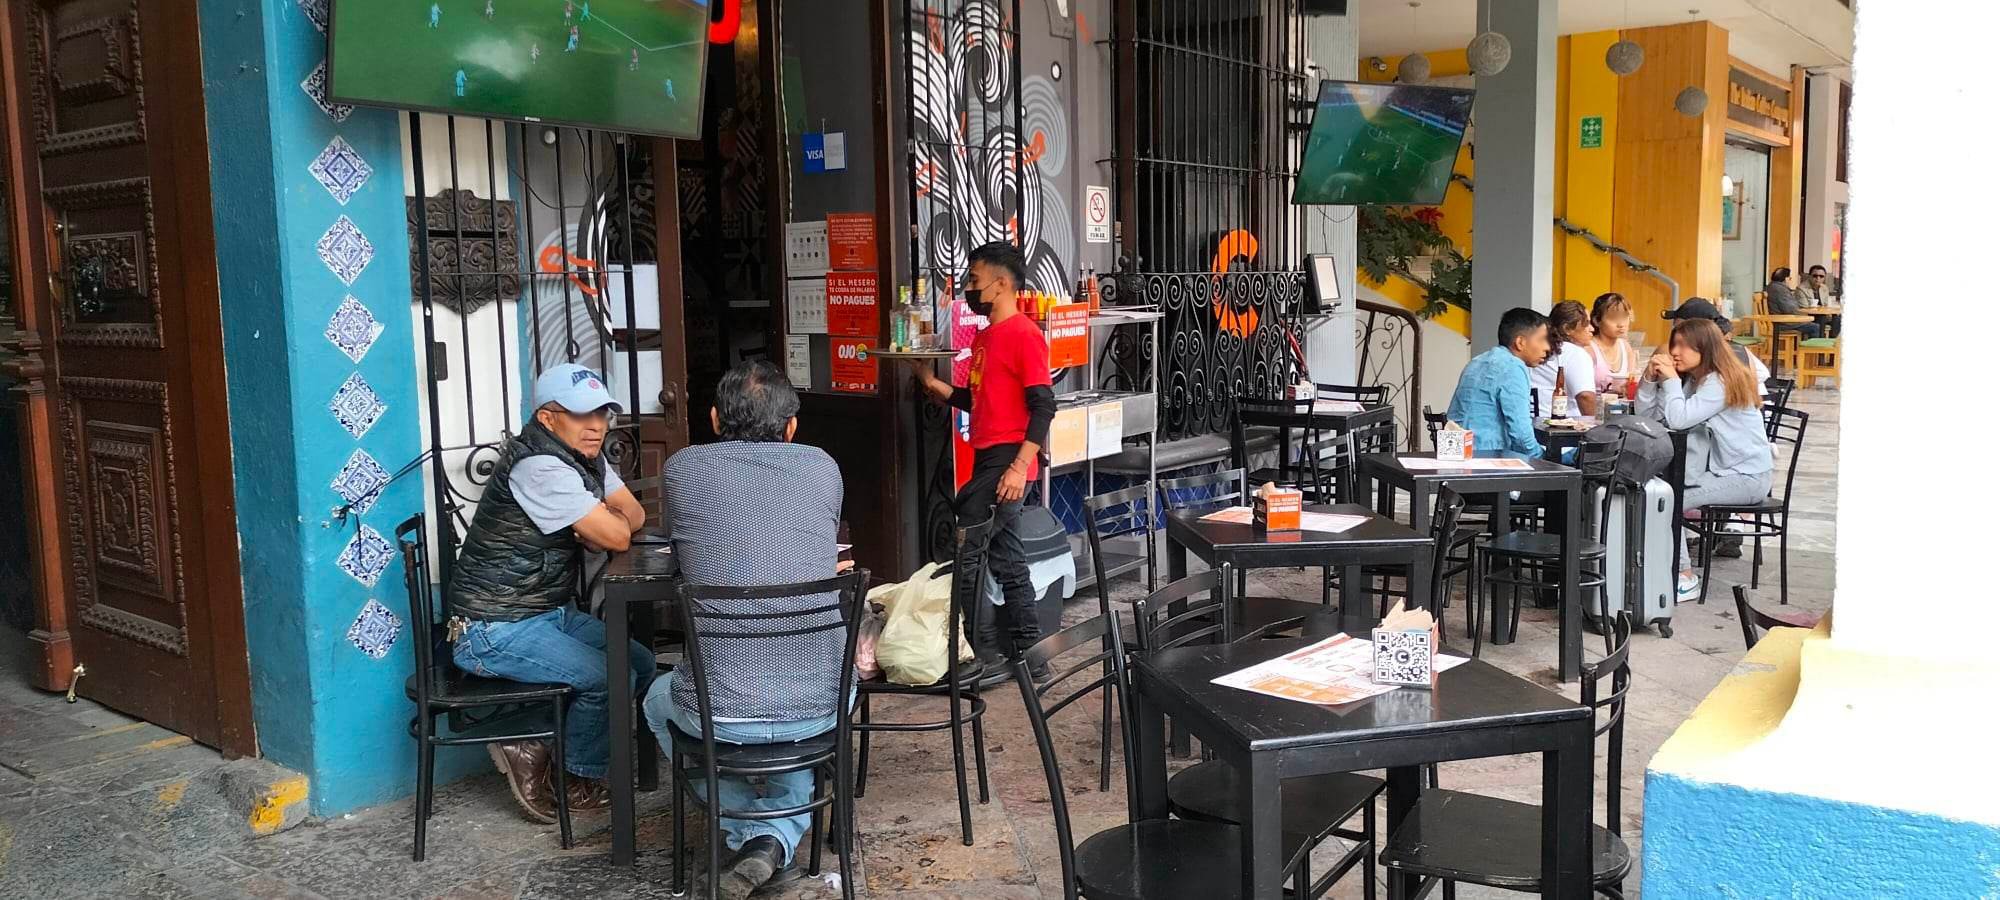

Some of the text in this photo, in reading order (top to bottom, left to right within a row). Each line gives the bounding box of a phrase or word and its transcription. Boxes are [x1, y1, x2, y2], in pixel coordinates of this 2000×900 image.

[806, 149, 824, 160] VISA
[830, 295, 875, 305] NO PAGUES
[838, 344, 856, 359] OJO
